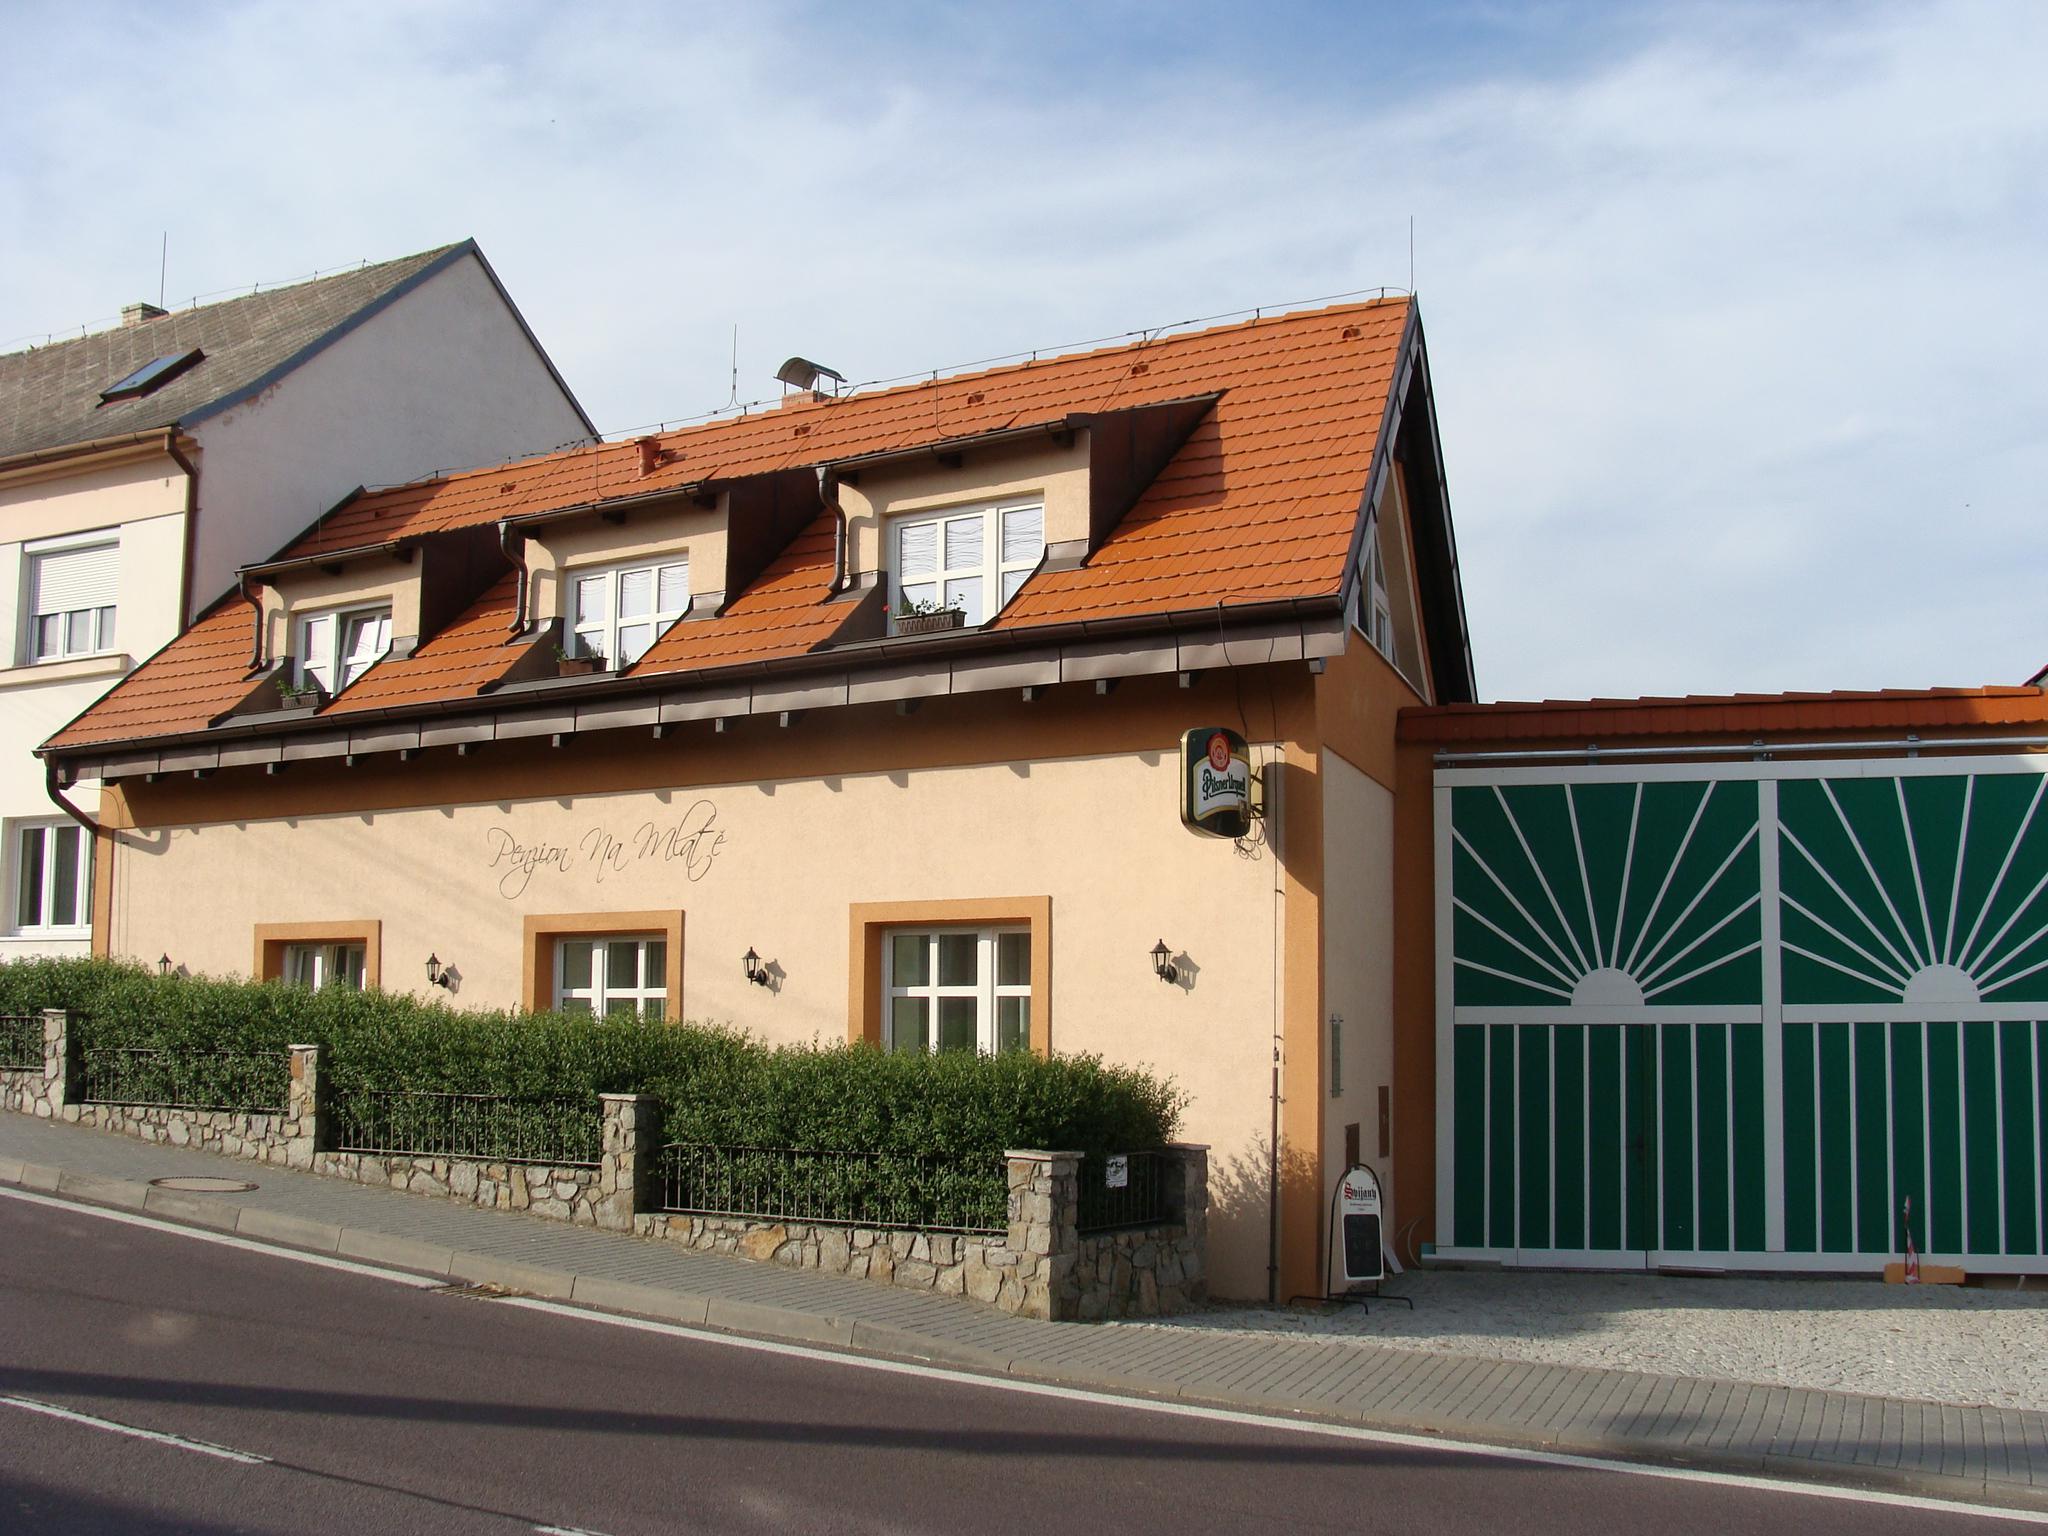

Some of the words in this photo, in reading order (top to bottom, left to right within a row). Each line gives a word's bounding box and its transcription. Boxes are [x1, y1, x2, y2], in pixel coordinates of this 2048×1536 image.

[1202, 768, 1229, 801] Pilsner
[487, 827, 574, 900] Penzion
[579, 827, 629, 883] Na
